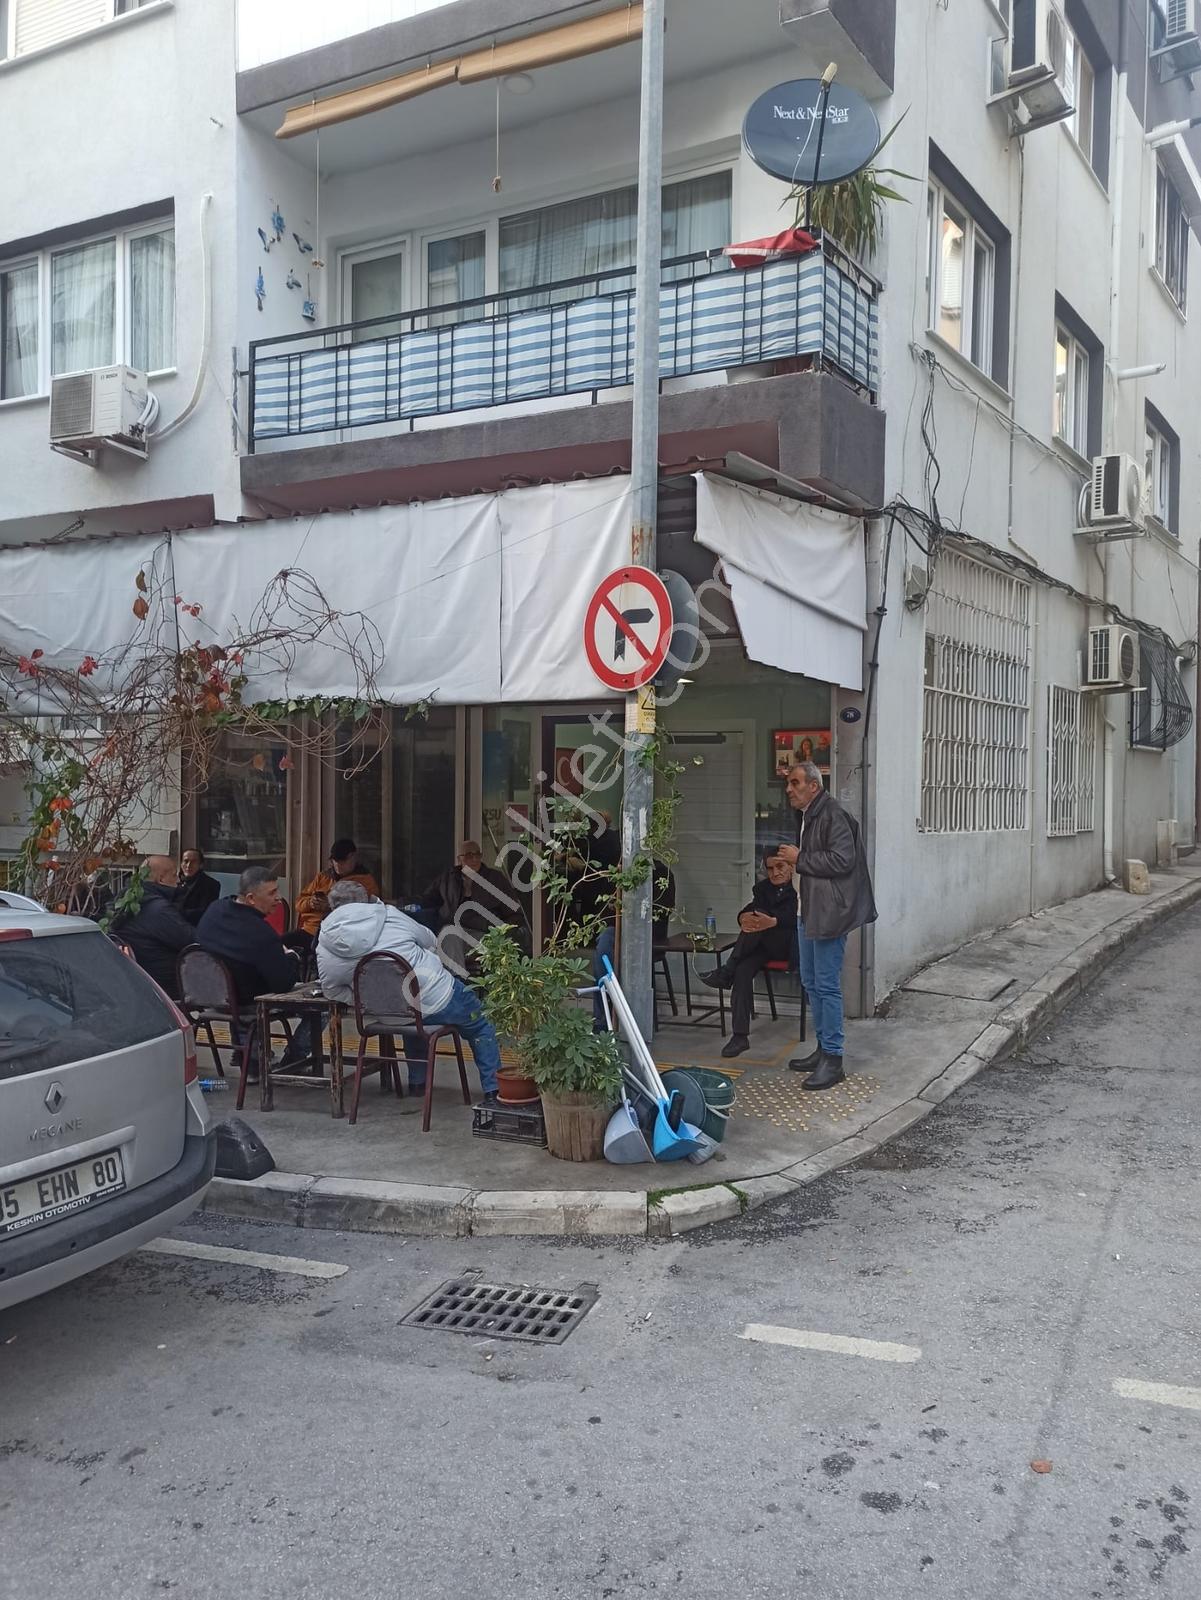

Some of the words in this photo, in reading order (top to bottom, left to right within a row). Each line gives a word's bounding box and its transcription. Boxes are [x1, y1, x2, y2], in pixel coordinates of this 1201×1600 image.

[773, 105, 795, 120] Next
[795, 106, 806, 120] &
[37, 1169, 80, 1208] EHN
[92, 1157, 118, 1187] 80
[7, 1213, 44, 1231] KESKİN
[45, 1195, 91, 1218] OTOMOTİV
